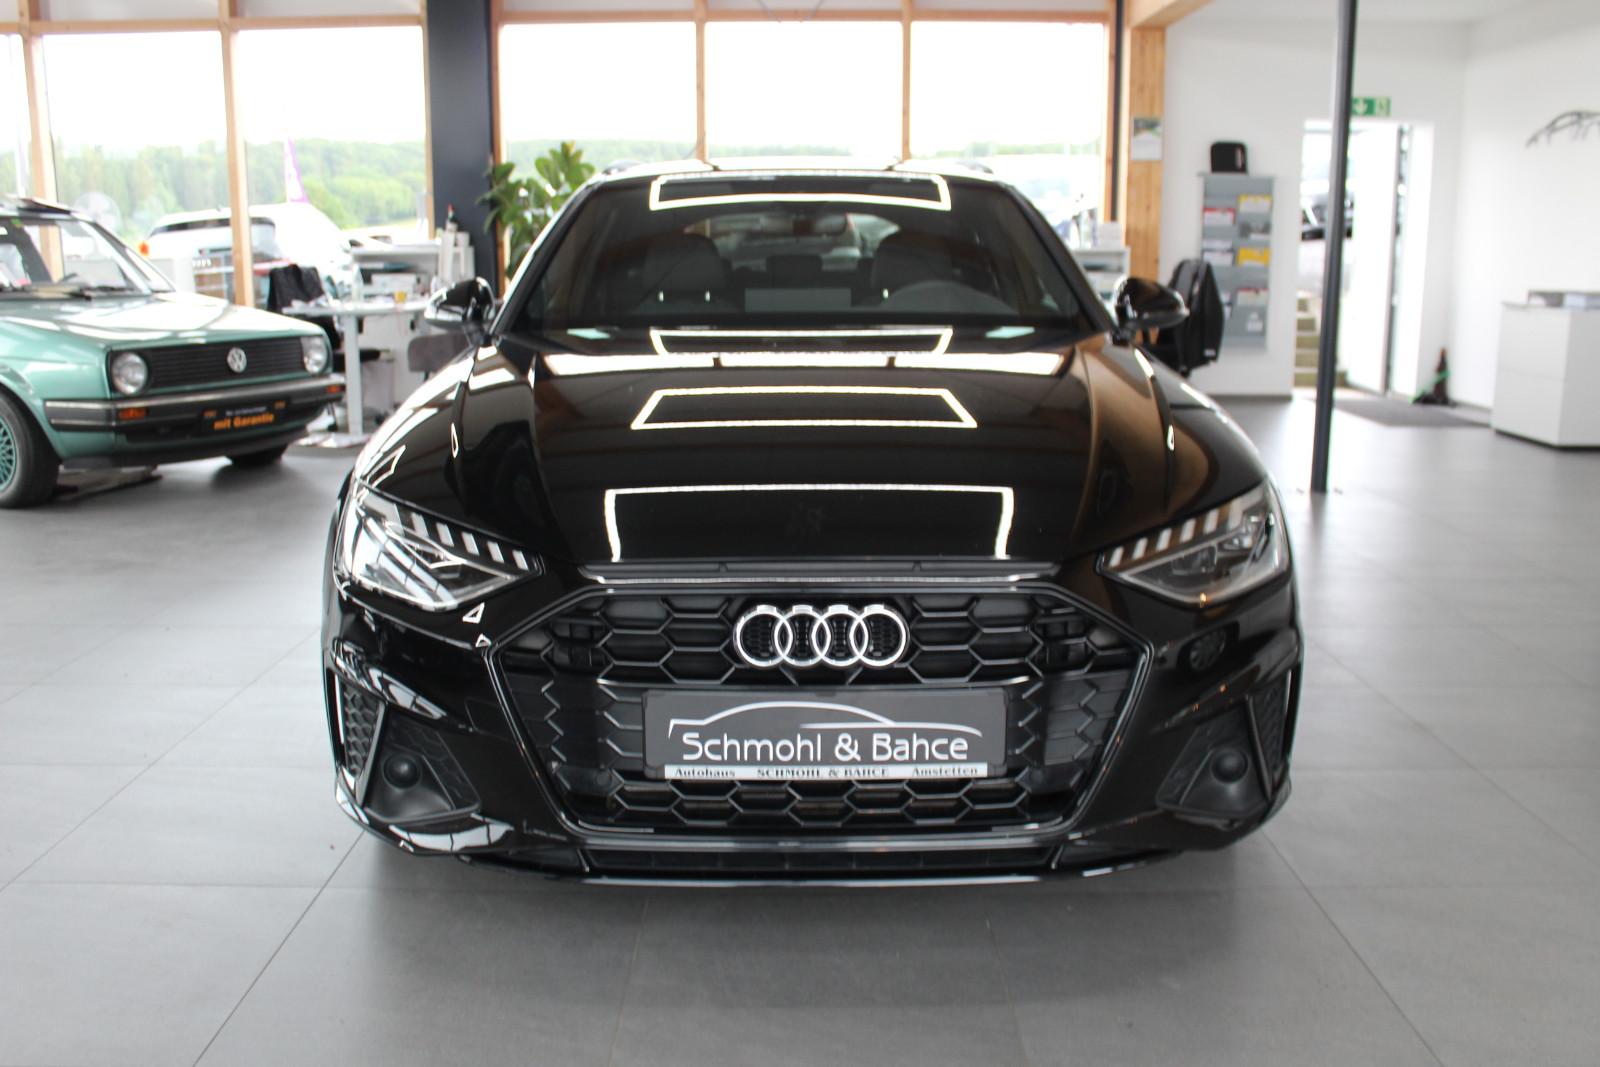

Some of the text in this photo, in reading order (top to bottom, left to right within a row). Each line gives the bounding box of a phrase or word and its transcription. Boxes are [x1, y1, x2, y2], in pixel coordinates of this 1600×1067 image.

[233, 412, 274, 428] Garantie
[682, 732, 968, 761] Schmohl & Bahce
[675, 766, 978, 778] Autohaus SCHMOHL & BAHCE Amstetten
